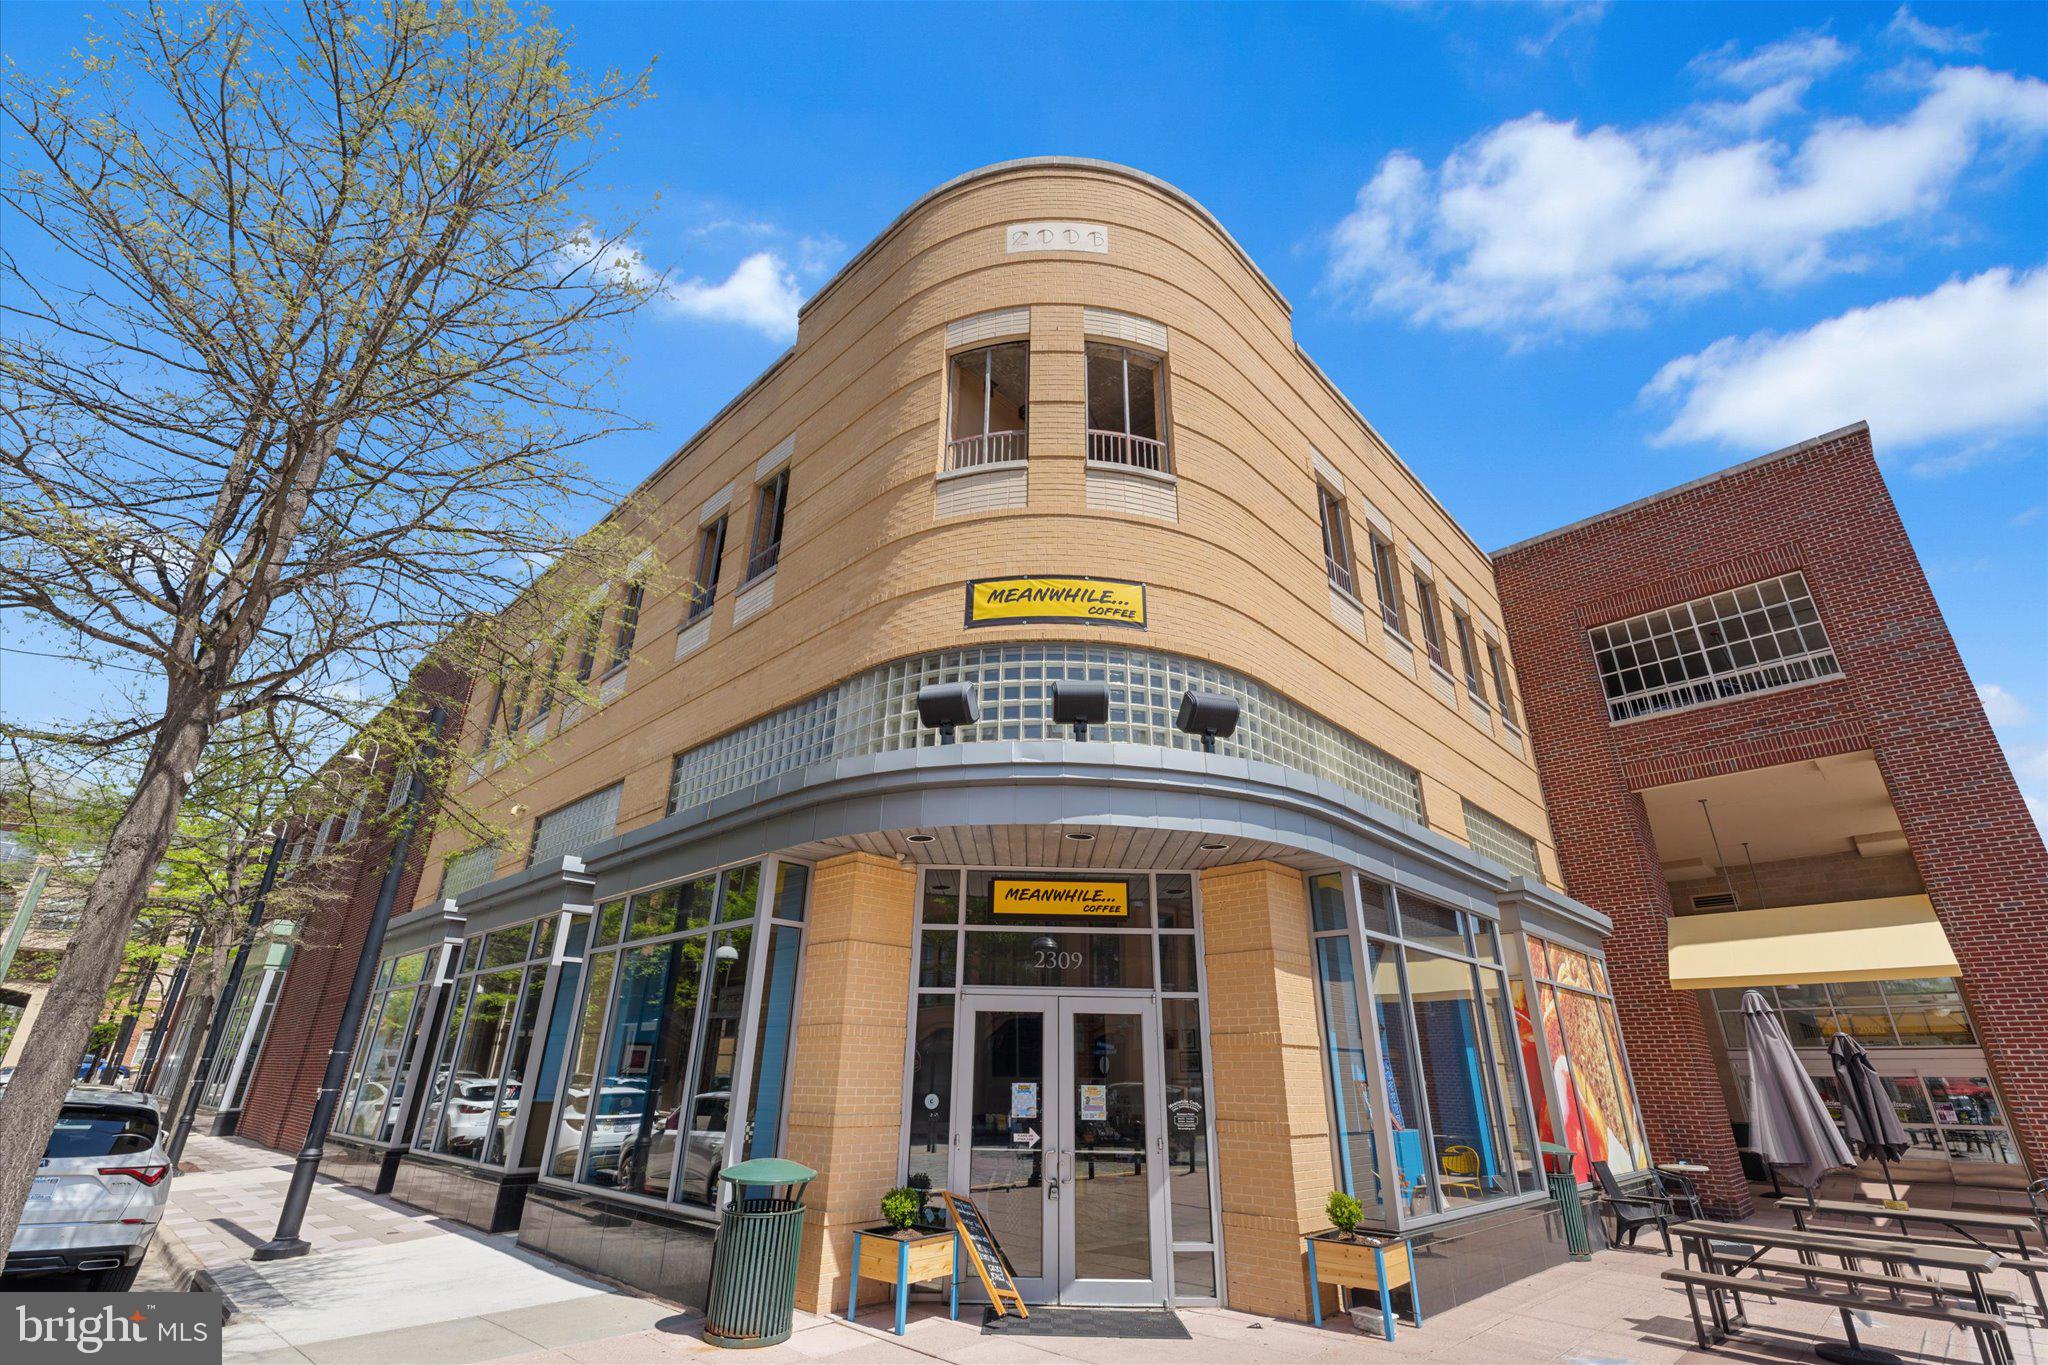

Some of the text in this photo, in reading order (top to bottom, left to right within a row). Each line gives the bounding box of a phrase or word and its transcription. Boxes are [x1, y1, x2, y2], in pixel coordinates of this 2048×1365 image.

[987, 587, 1129, 606] MEANWHILE...
[1088, 606, 1137, 619] COFFEE
[1004, 887, 1116, 903] MEANWHILE...
[1083, 905, 1122, 913] COFFEE
[1033, 950, 1083, 970] 2309
